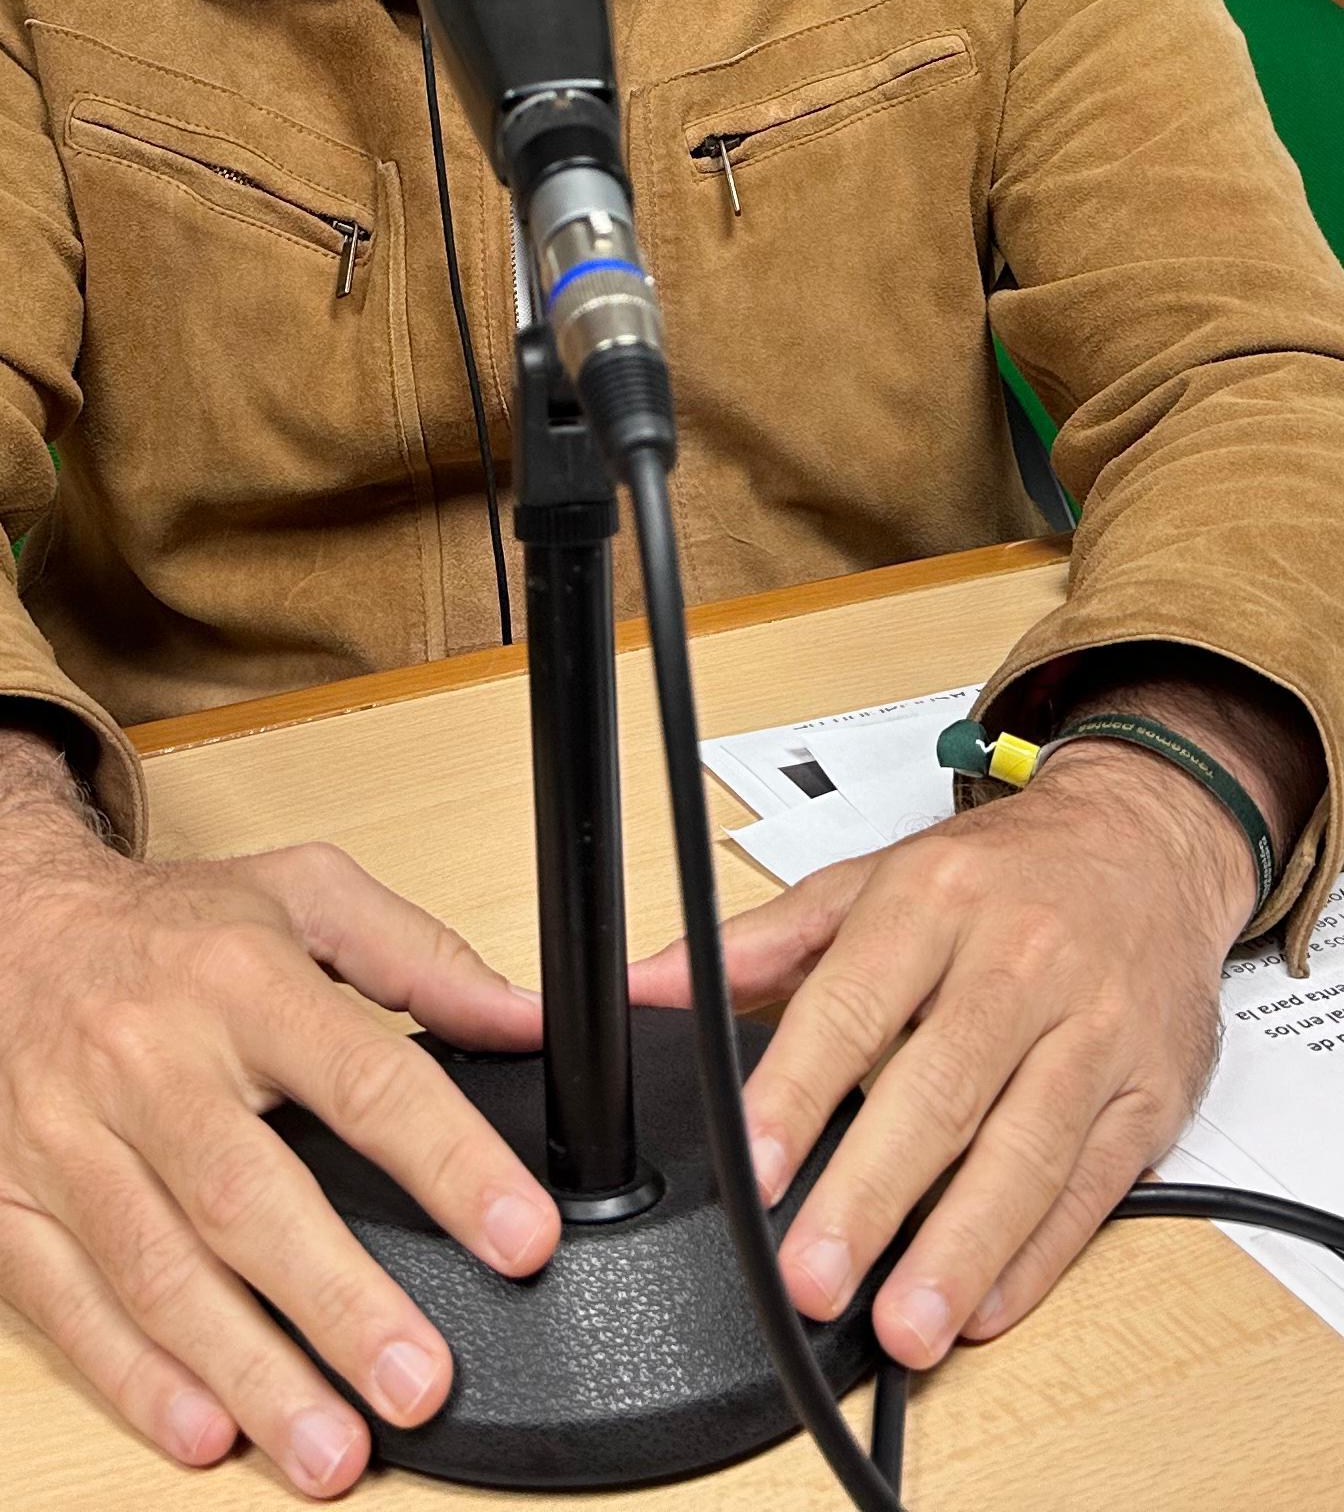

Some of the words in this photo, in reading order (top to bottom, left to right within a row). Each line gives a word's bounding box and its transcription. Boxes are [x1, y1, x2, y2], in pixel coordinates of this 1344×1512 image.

[1303, 942, 1323, 952] a
[1257, 993, 1304, 1014] para
[1234, 1009, 1260, 1020] la
[1296, 1015, 1324, 1028] en
[1263, 1023, 1300, 1038] los
[1306, 1038, 1334, 1051] de
